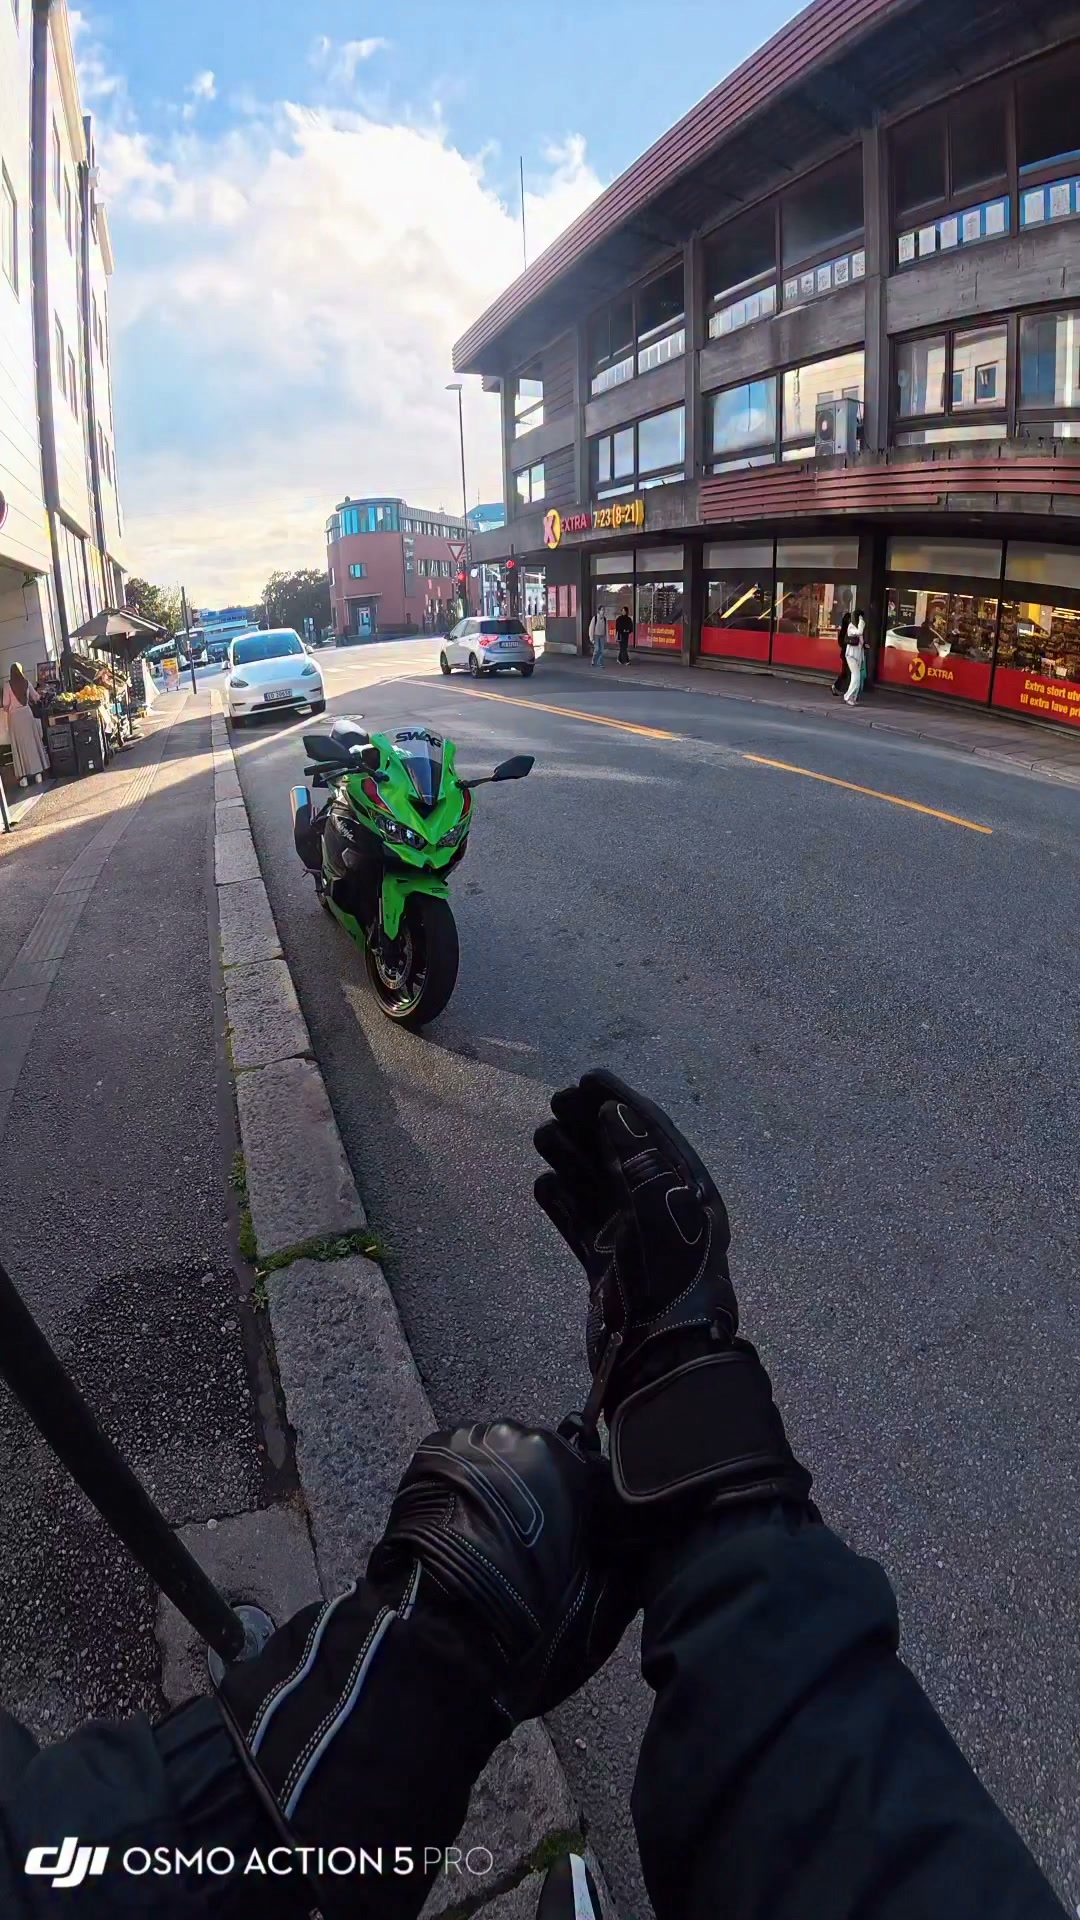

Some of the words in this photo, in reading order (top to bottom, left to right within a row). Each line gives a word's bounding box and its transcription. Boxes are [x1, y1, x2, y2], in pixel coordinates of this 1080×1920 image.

[560, 513, 588, 533] EXTRA
[593, 507, 611, 529] 7-23
[612, 499, 640, 529] (8-21)
[927, 667, 954, 681] EXTRA
[1025, 679, 1045, 693] Extra
[1046, 685, 1066, 698] stort
[1020, 693, 1028, 704] til
[1029, 697, 1050, 710] extra
[1051, 700, 1068, 714] lave
[395, 730, 442, 748] SWAG
[338, 819, 356, 842] Ninja
